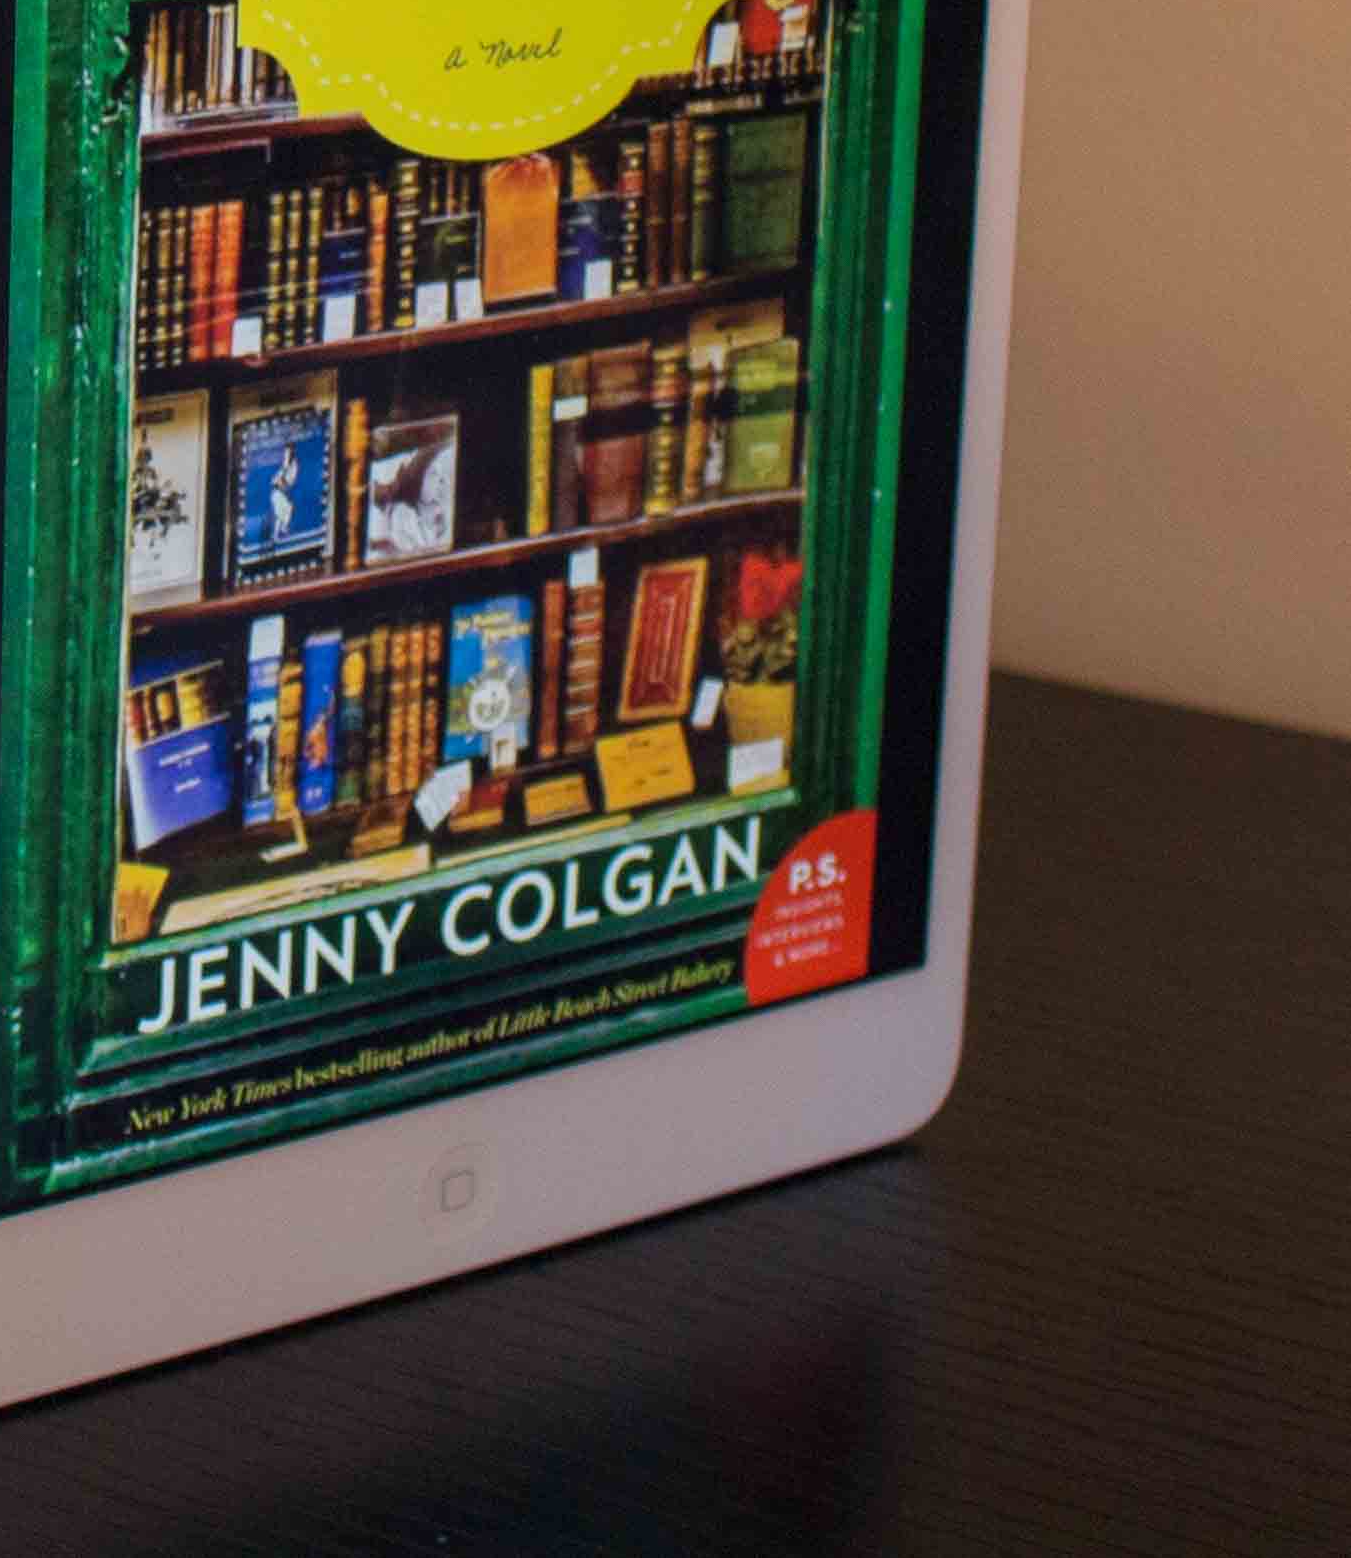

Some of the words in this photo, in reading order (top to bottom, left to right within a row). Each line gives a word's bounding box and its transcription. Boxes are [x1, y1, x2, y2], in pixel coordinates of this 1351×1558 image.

[443, 46, 467, 72] a
[137, 903, 414, 1036] JENNY
[441, 817, 760, 957] COLGAN
[787, 851, 848, 896] P.S.
[128, 1107, 176, 1132] New
[179, 1086, 228, 1121] York
[232, 1076, 293, 1107] Times
[294, 1046, 403, 1092] bestselling
[406, 1031, 471, 1061] author
[498, 1002, 551, 1040] Little
[553, 986, 612, 1024] Beach
[615, 974, 668, 1005] Street
[671, 958, 735, 994] Bakery
